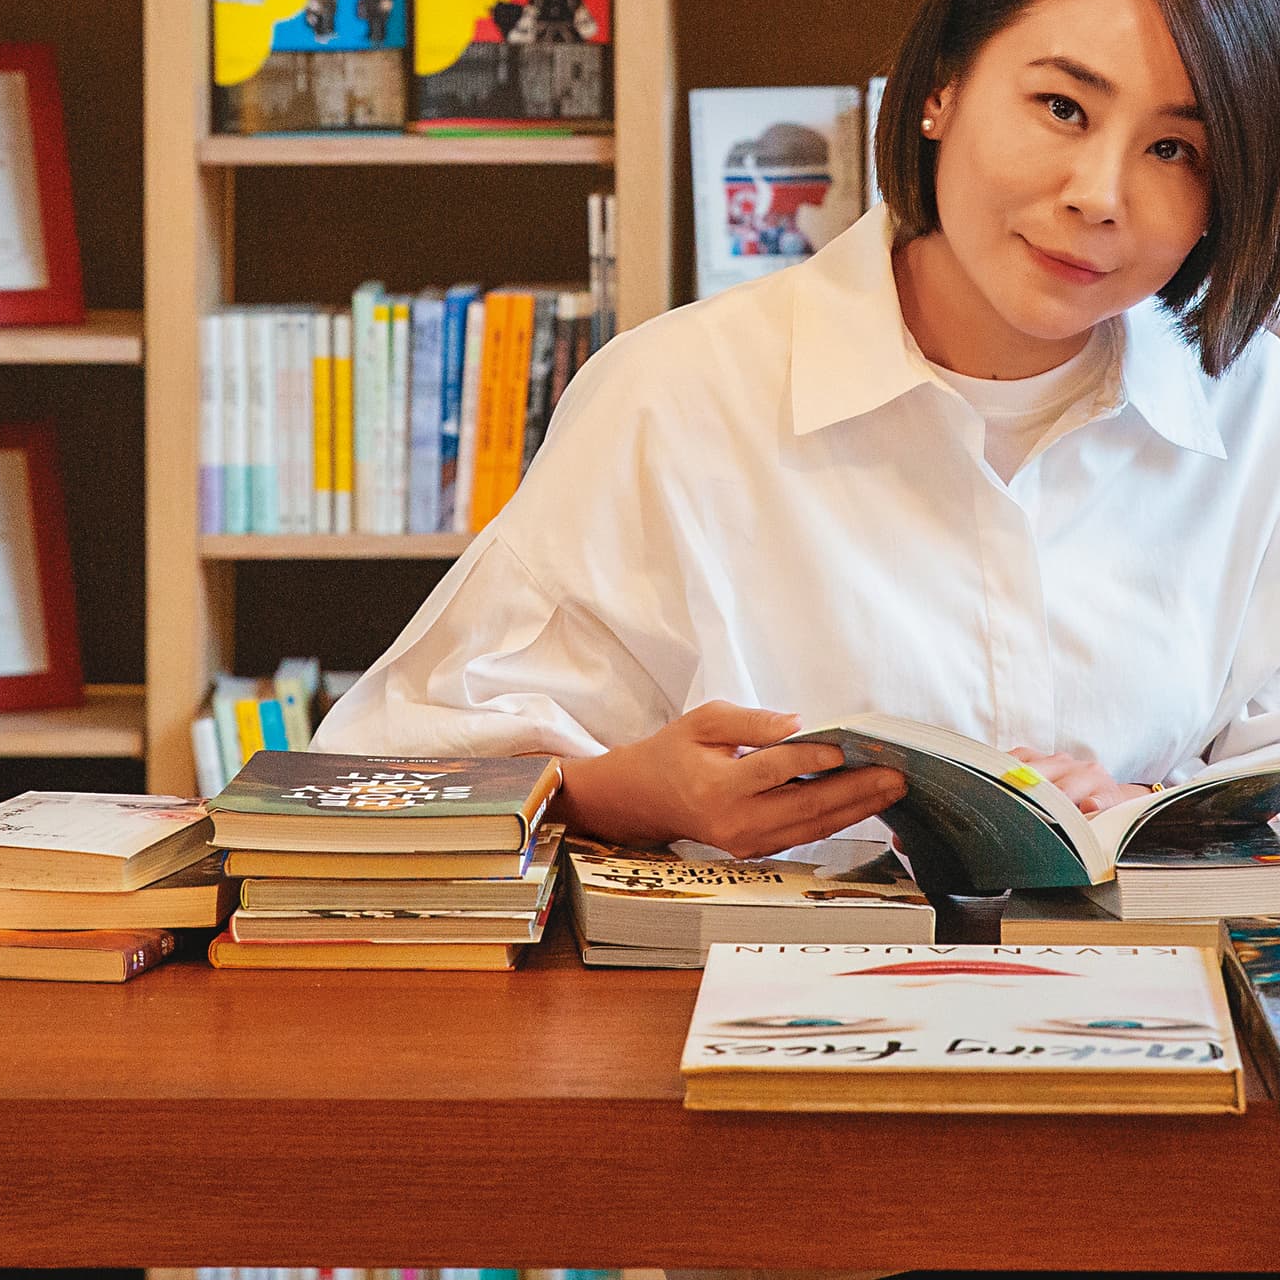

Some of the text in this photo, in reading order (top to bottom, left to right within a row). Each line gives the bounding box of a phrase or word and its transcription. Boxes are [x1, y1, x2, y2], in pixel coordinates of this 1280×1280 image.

[336, 772, 448, 780] ART
[288, 785, 473, 793] STORY
[280, 791, 472, 800] SHORT
[317, 799, 424, 807] THE
[734, 946, 1177, 956] KEVYN AUCOIN
